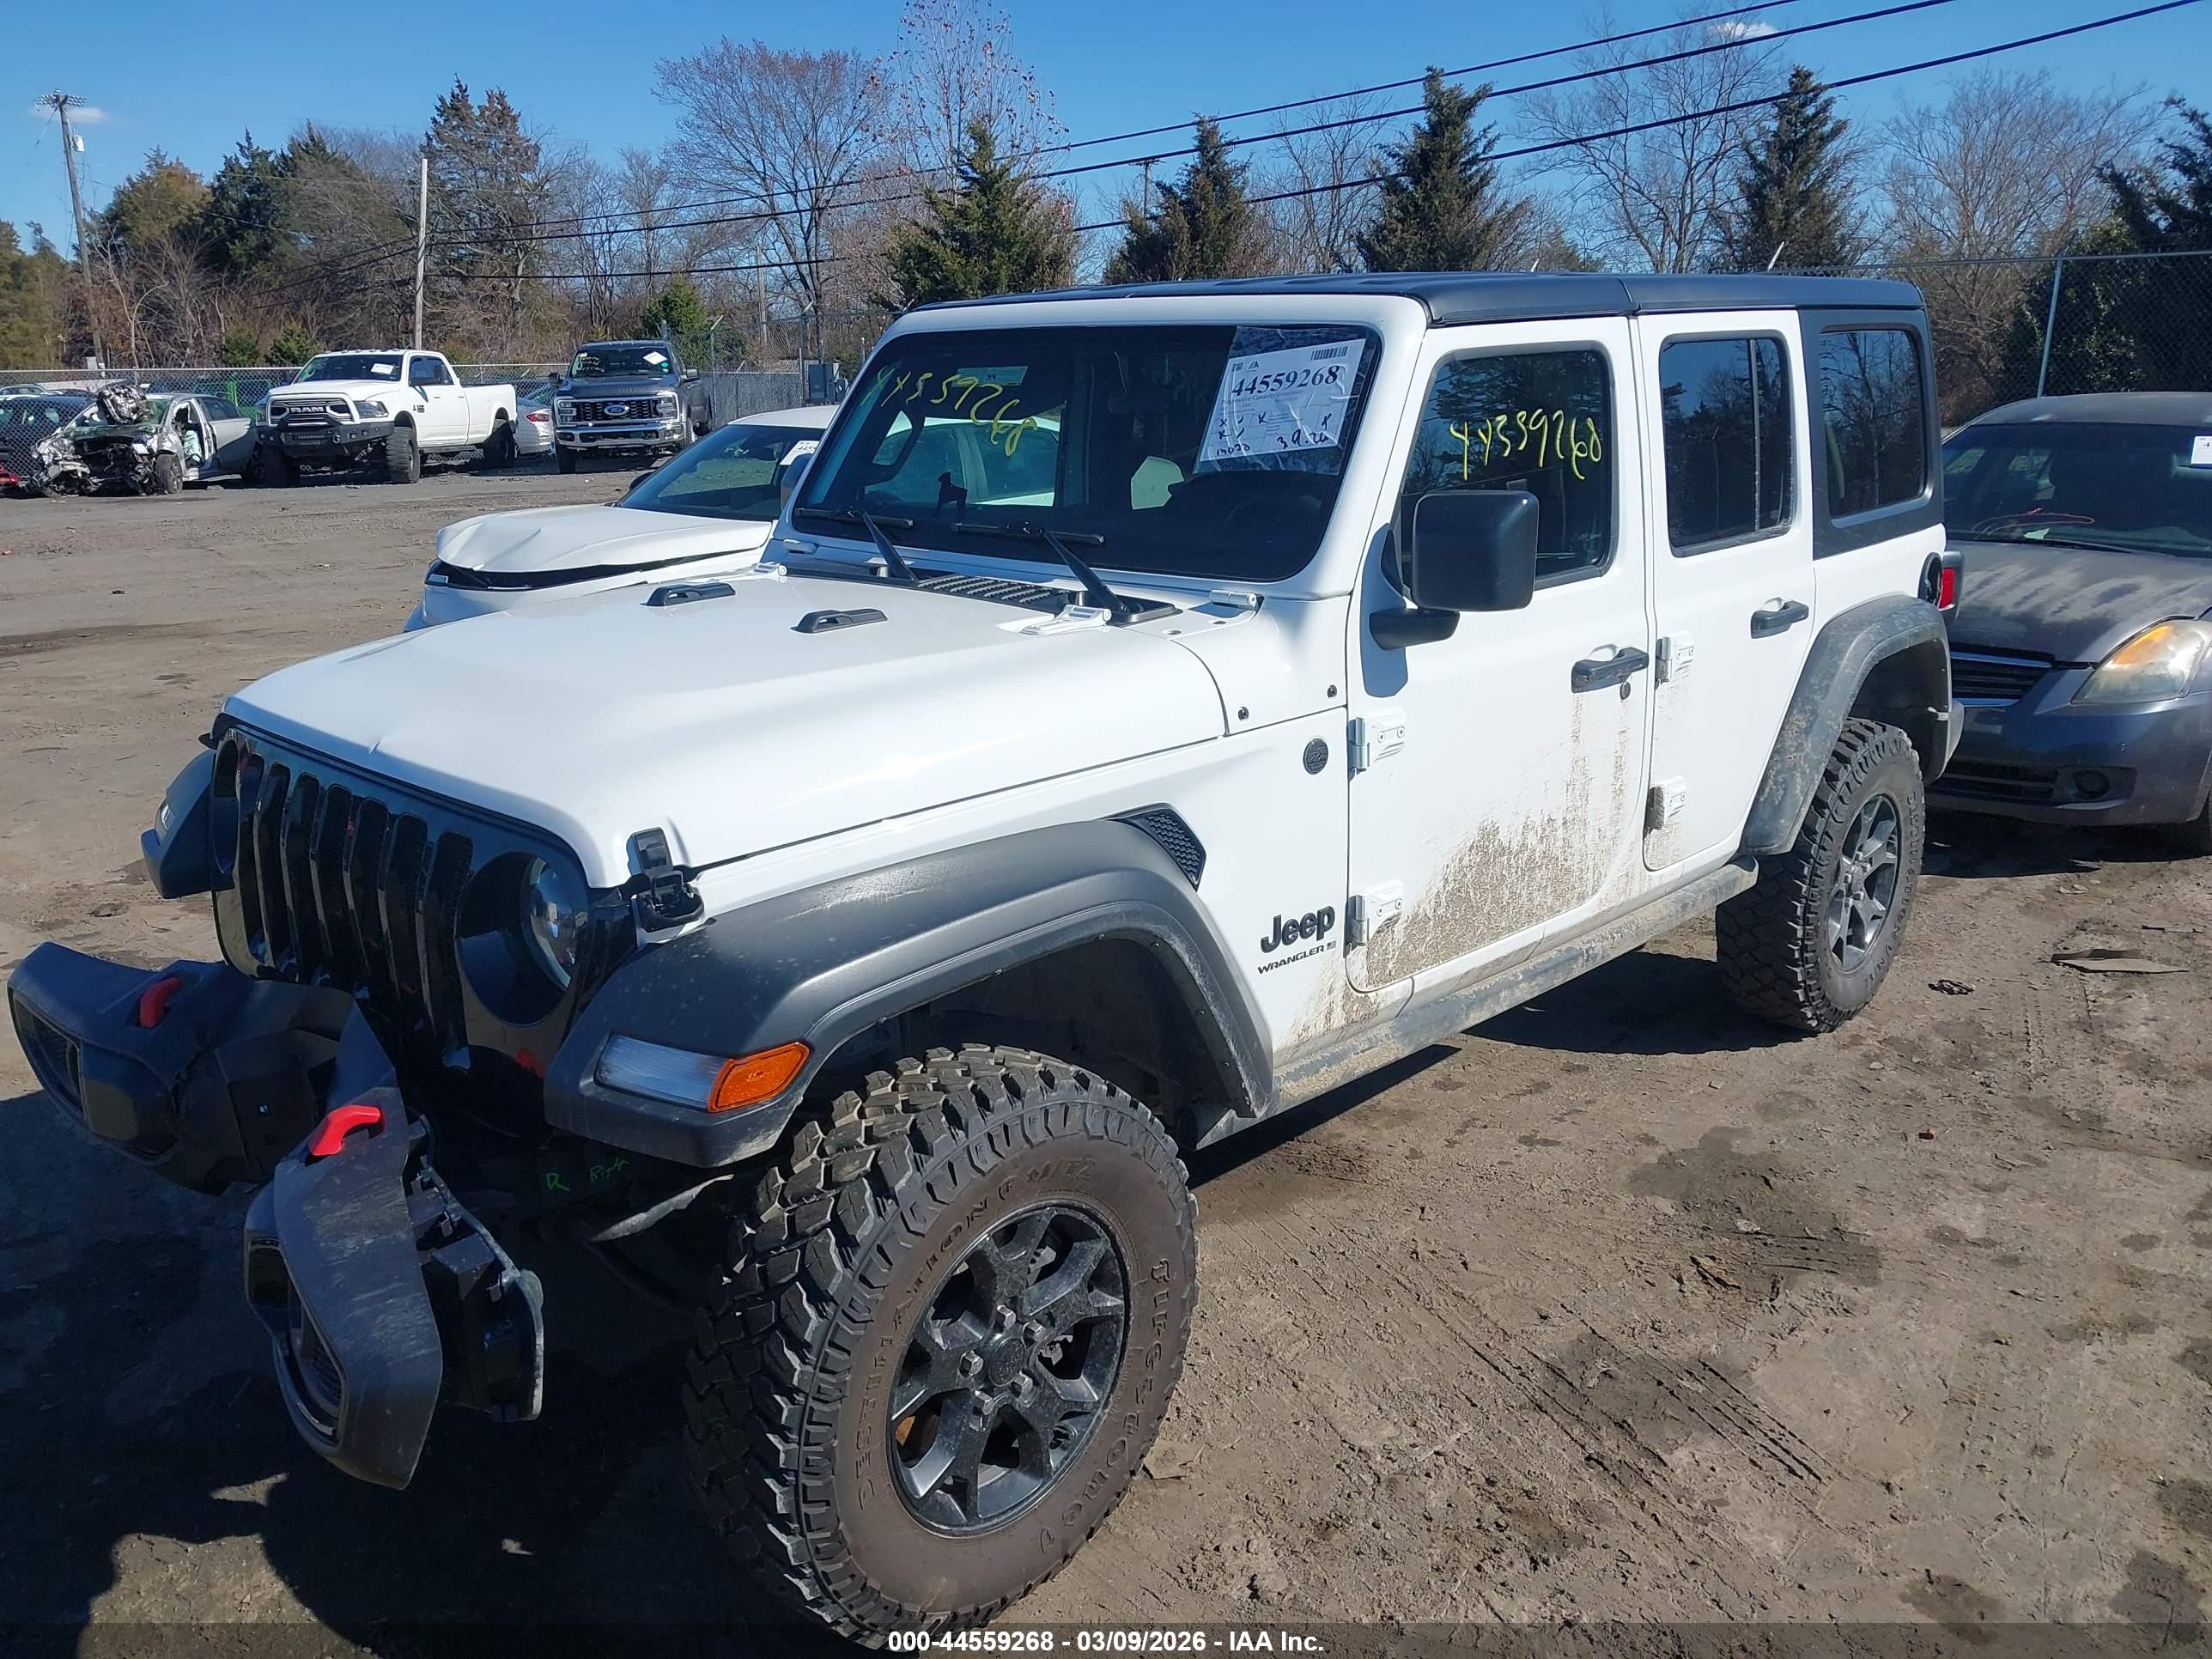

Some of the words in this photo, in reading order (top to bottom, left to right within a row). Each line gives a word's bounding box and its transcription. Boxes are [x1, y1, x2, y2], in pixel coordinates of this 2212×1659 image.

[1231, 364, 1341, 396] 44559268
[1260, 905, 1335, 954] Jeep
[1257, 944, 1325, 975] WRANGLER
